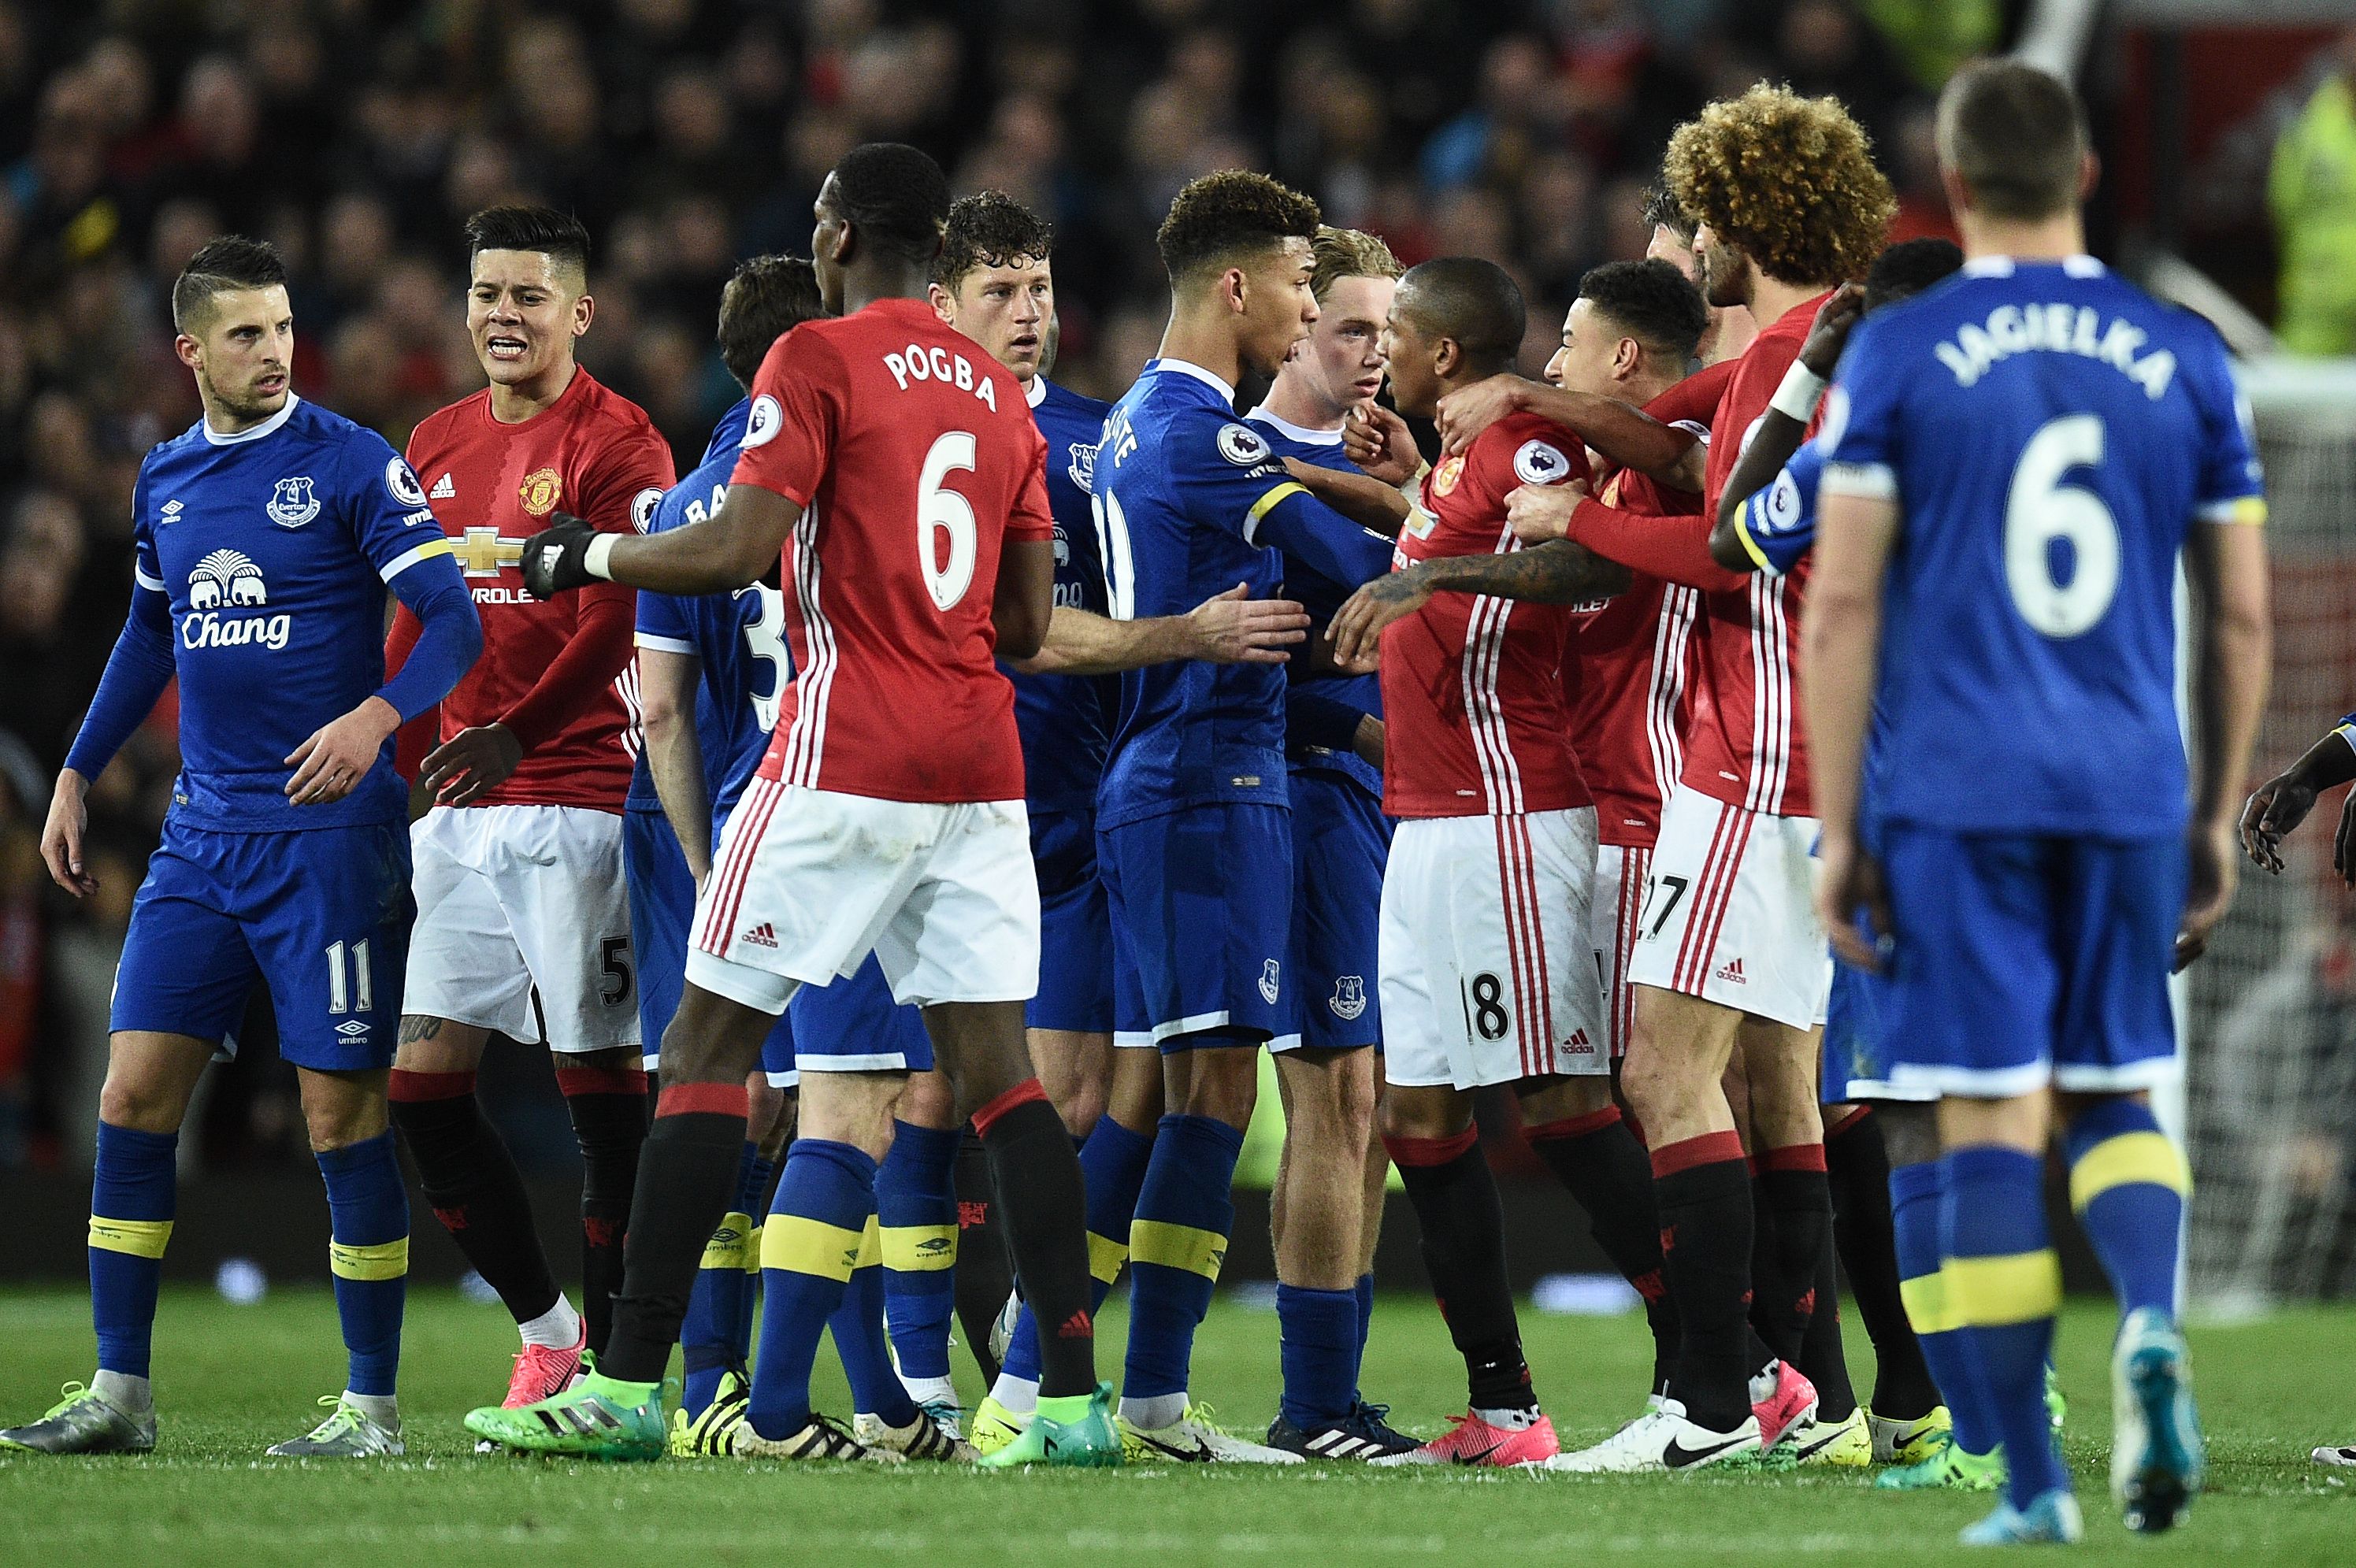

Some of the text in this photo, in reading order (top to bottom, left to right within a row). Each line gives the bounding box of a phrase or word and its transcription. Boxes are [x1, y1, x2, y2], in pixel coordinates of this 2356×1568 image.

[883, 343, 997, 413] POGBA
[1935, 303, 2177, 401] JAGIELKA
[916, 430, 977, 611] 6
[2002, 413, 2122, 639] 6
[182, 612, 291, 650] Chang
[731, 580, 789, 734] 3
[325, 937, 373, 1014] 11
[600, 935, 633, 1008] 5
[742, 934, 778, 948] adidas
[1716, 969, 1746, 984] adidas
[338, 1035, 368, 1045] umbro
[1560, 1042, 1595, 1055] adidas
